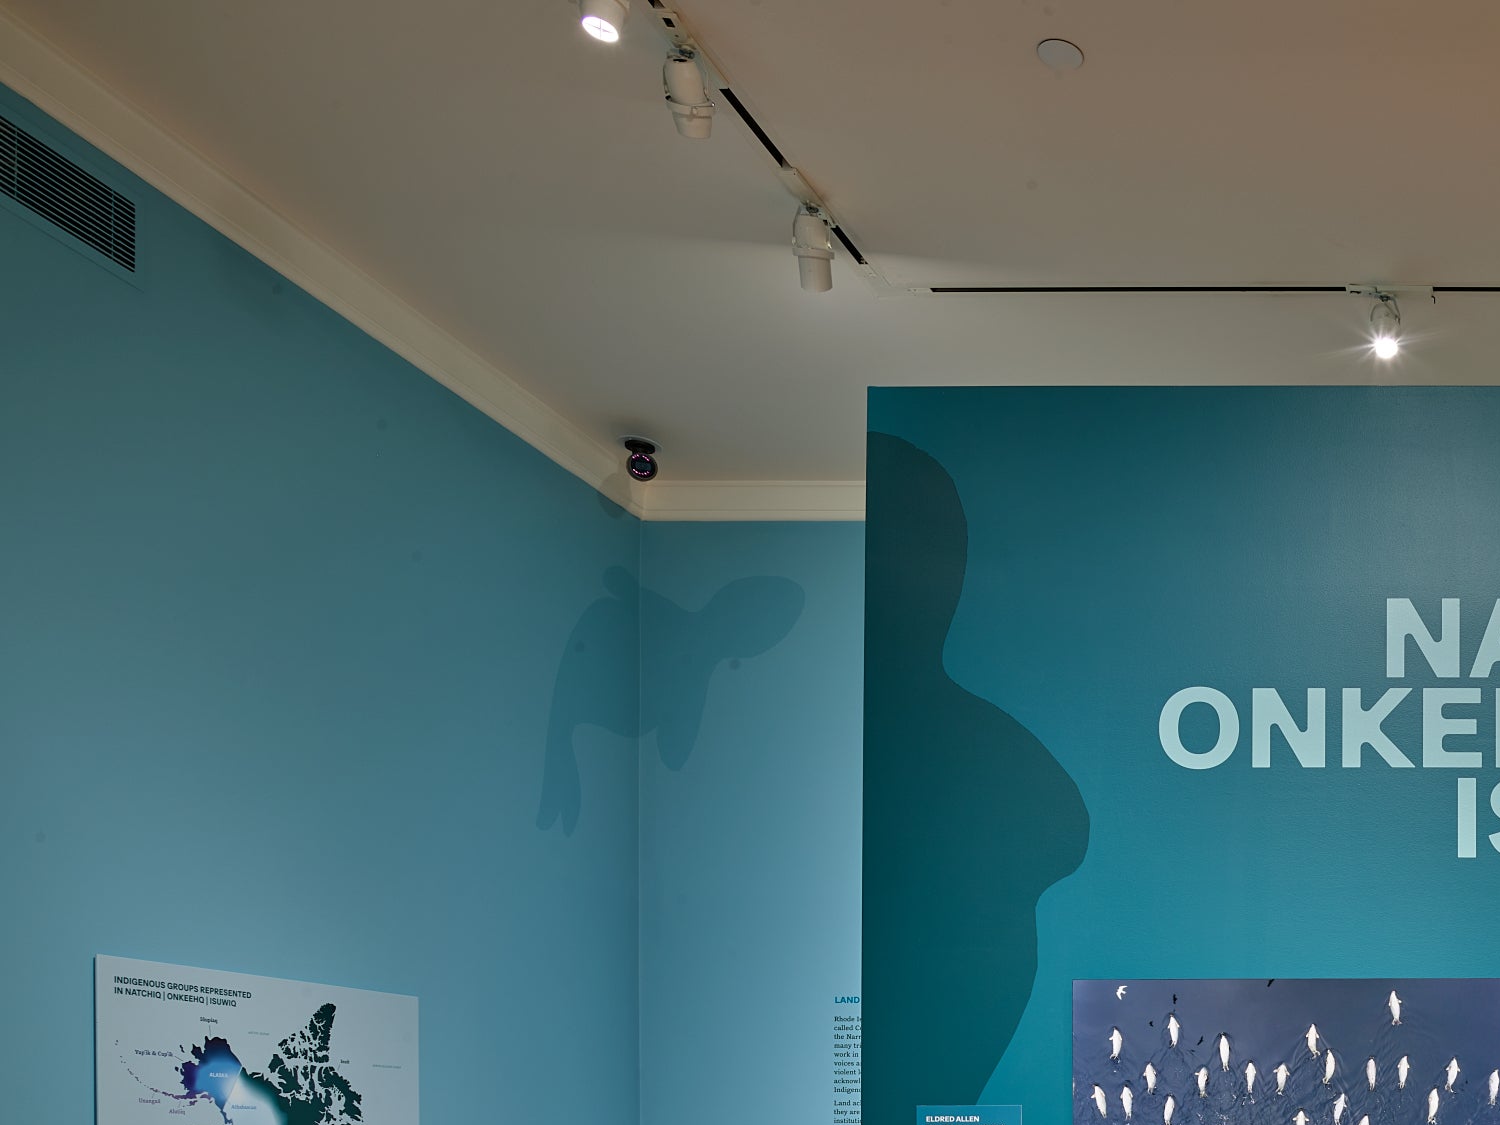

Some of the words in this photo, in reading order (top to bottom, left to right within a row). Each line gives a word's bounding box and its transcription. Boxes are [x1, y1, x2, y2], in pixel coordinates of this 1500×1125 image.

[114, 975, 165, 989] INDIGENOUS
[167, 982, 198, 993] GROUPS
[200, 986, 252, 999] REPRESENTED
[114, 986, 123, 995] IN
[125, 987, 161, 999] NATCHIQ
[167, 992, 205, 1004] ONKEEHQ
[210, 997, 237, 1007] ISUWIQ
[834, 996, 861, 1004] LAND
